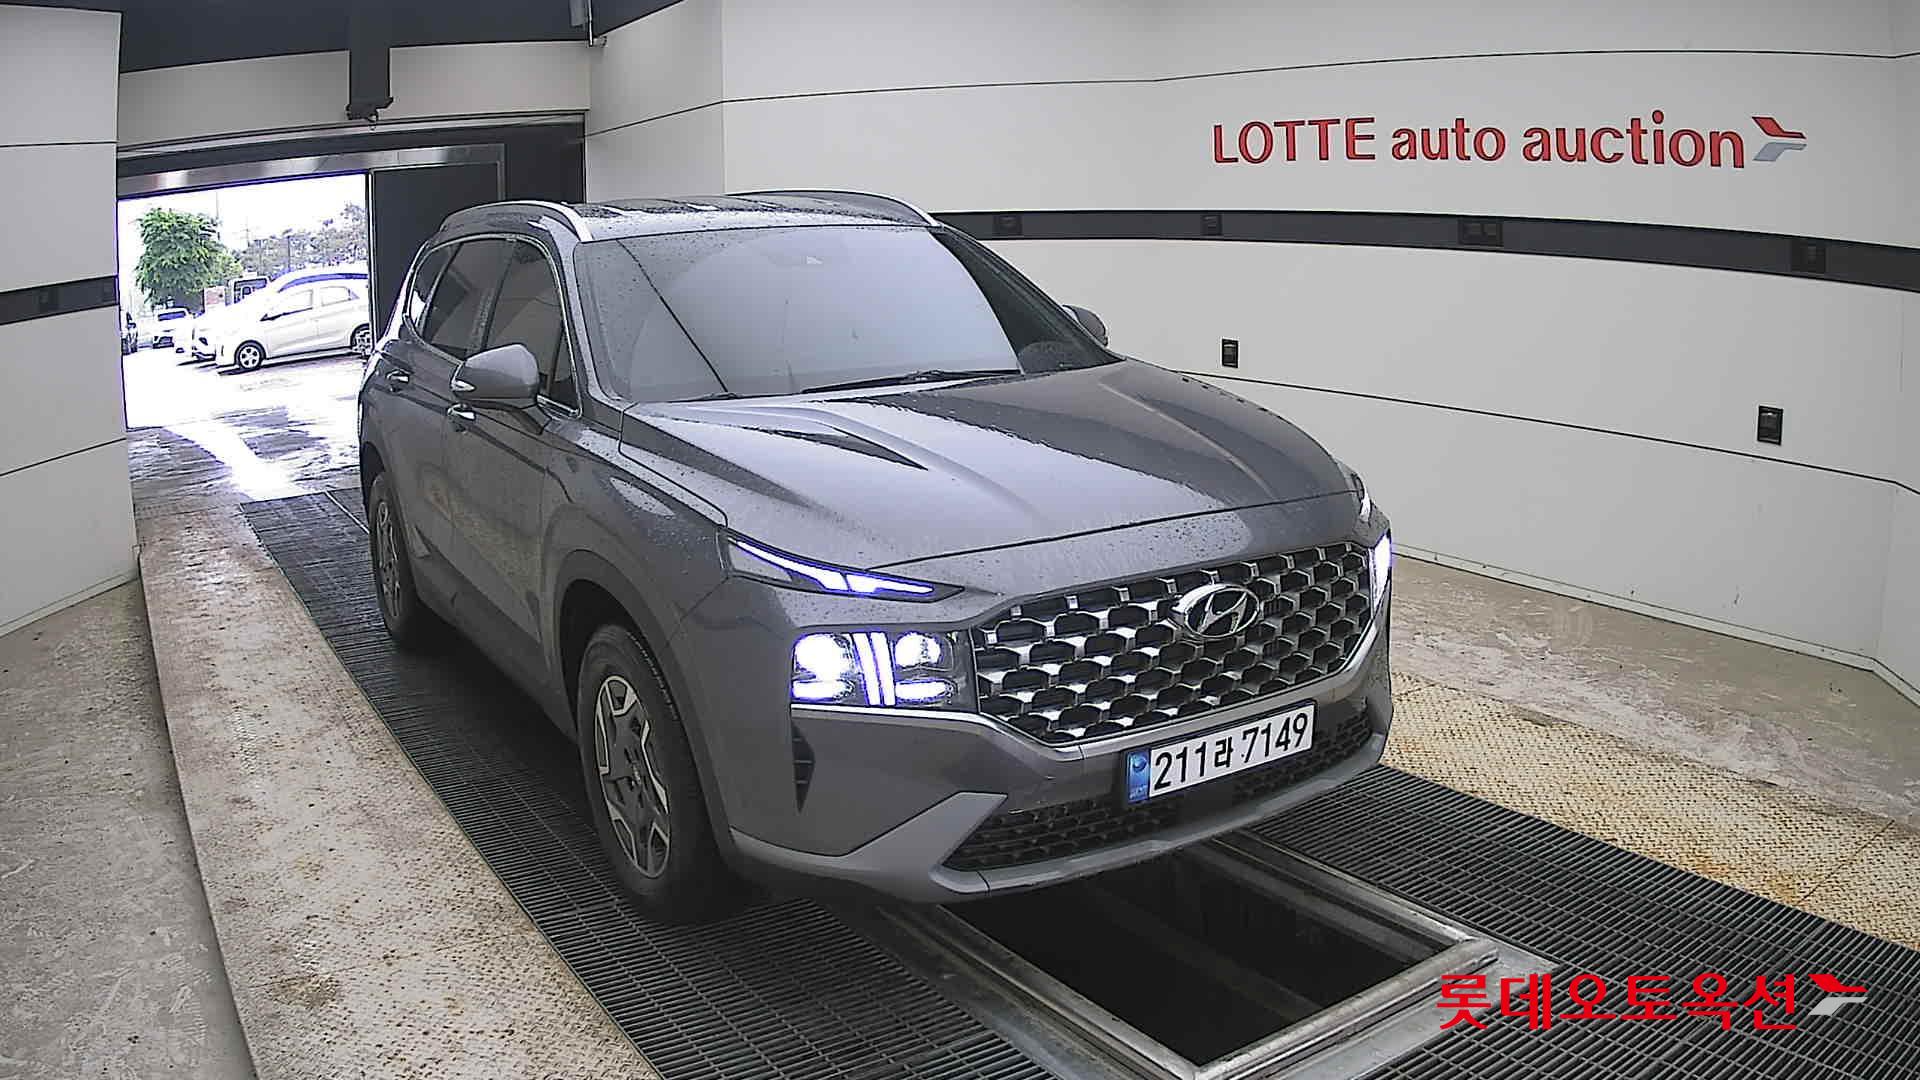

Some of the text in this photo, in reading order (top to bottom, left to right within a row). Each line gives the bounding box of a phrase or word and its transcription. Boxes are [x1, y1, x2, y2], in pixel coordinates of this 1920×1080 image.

[1212, 110, 1746, 169] LOTTE auto auction
